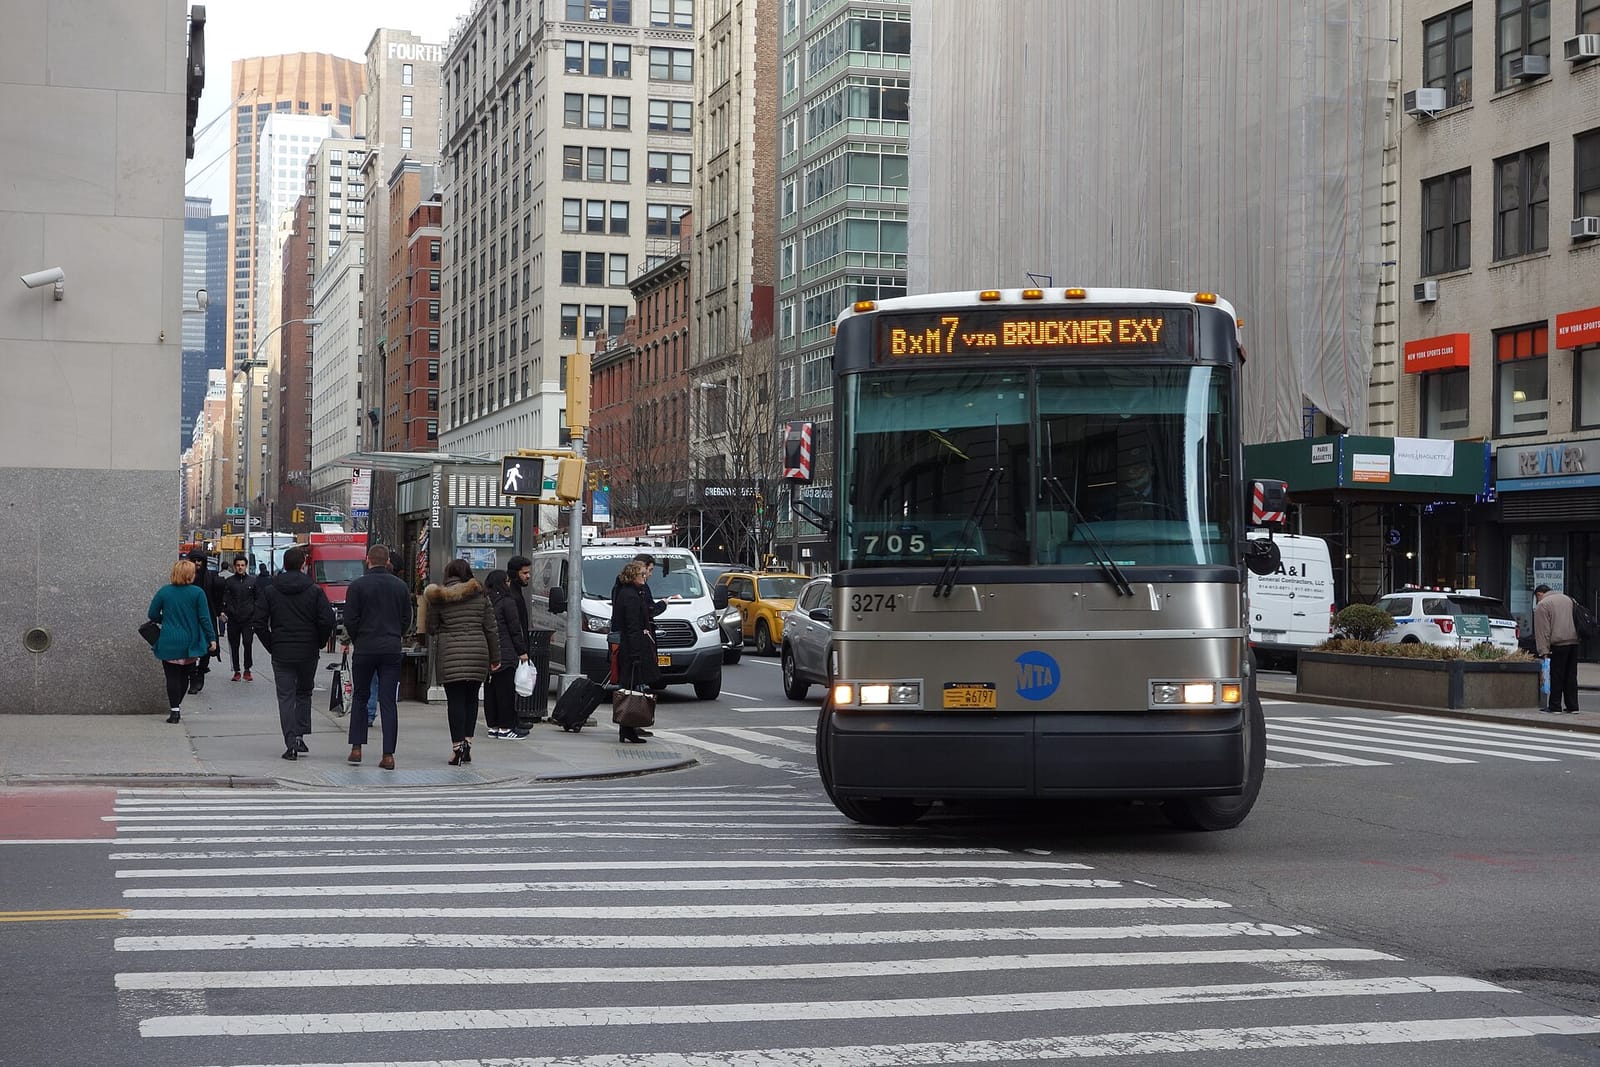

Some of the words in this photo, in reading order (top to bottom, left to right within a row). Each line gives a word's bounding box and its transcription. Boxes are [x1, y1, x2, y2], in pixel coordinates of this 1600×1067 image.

[388, 43, 442, 61] FOURTH
[1003, 320, 1113, 346] BRUCKNER
[1118, 318, 1163, 343] EXY
[1559, 326, 1569, 335] NEW
[1570, 324, 1582, 333] YORK
[1583, 320, 1600, 331] SPORTS
[1426, 348, 1441, 358] SPORTS
[432, 472, 442, 529] Newsstand
[863, 535, 926, 554] 705
[1288, 565, 1298, 577] &
[851, 594, 897, 613] 3274
[1015, 662, 1054, 691] MTA
[972, 690, 993, 703] 6797
